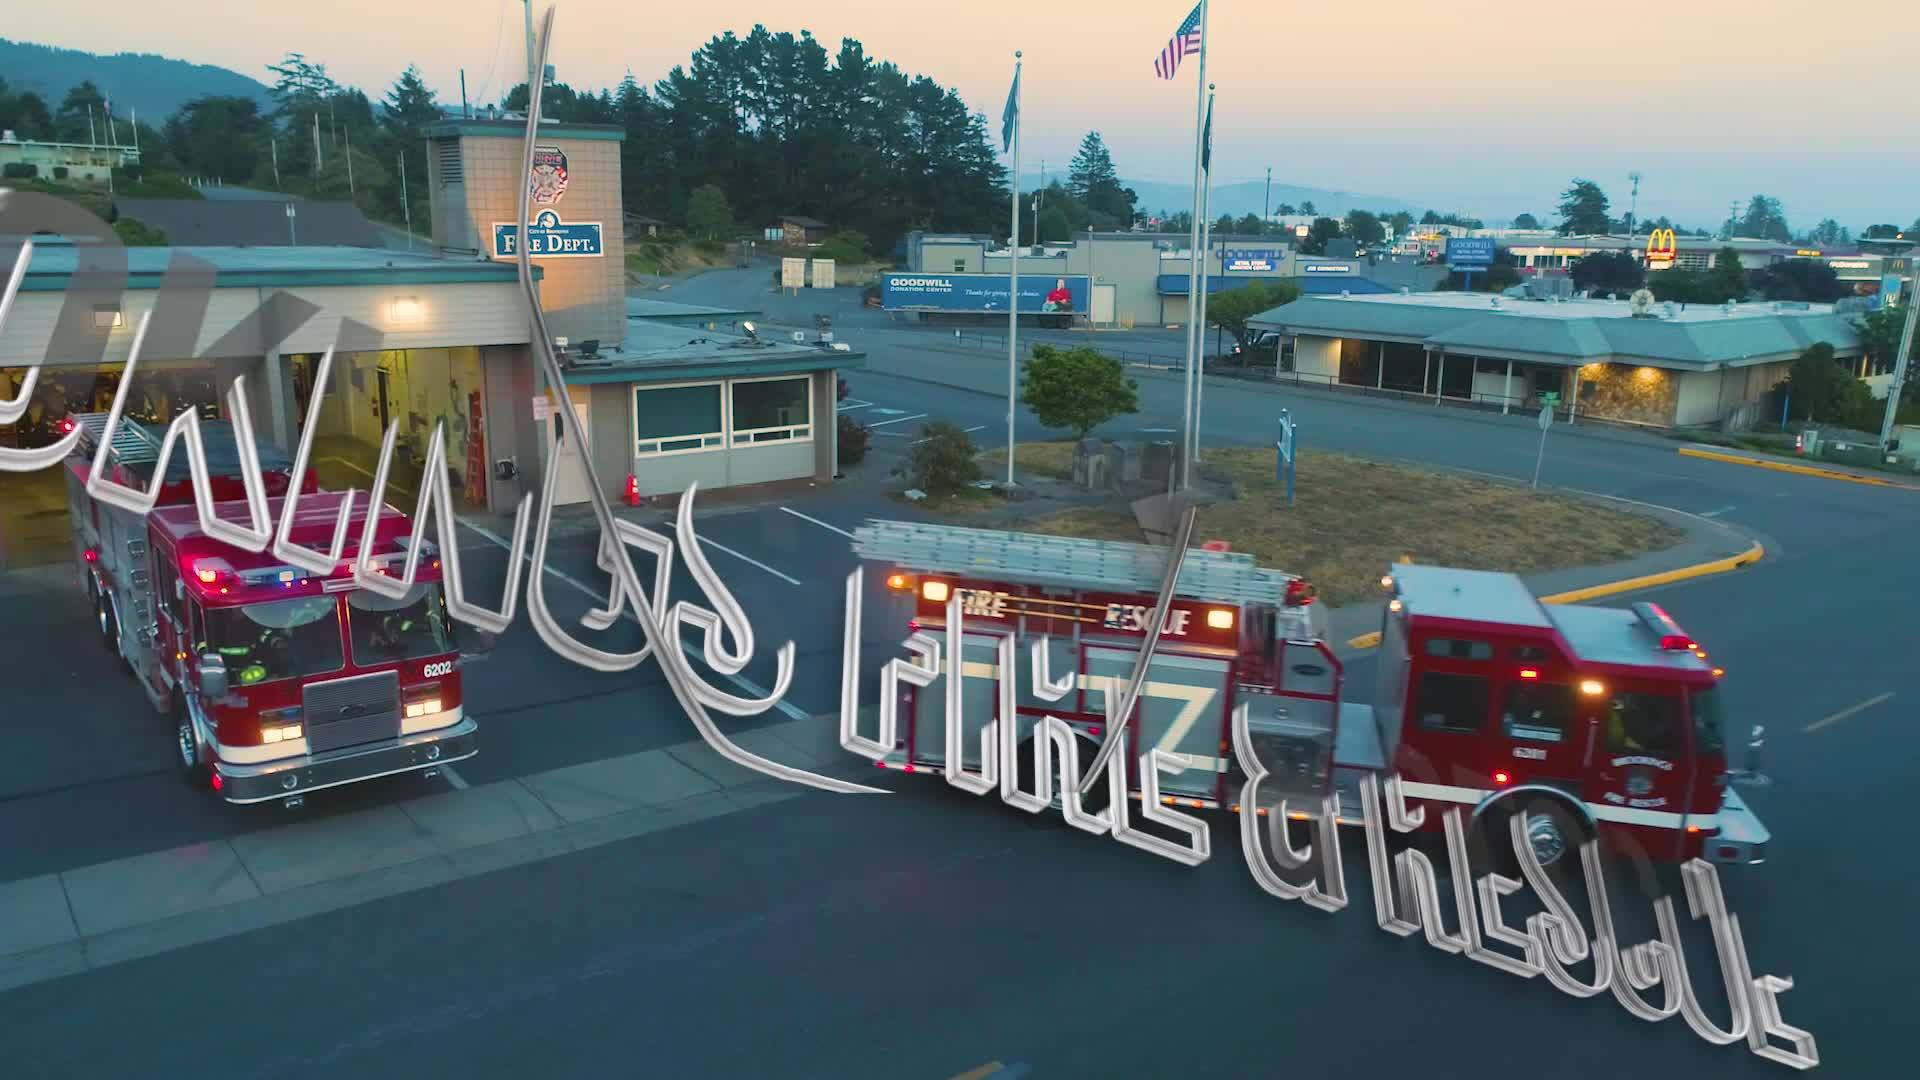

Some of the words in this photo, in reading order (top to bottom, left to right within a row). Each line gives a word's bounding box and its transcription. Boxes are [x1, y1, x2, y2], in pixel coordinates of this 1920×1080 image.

[503, 235, 542, 253] FE
[547, 235, 595, 252] DEPT.
[890, 278, 952, 287] GOODWILL
[423, 661, 453, 678] 6202
